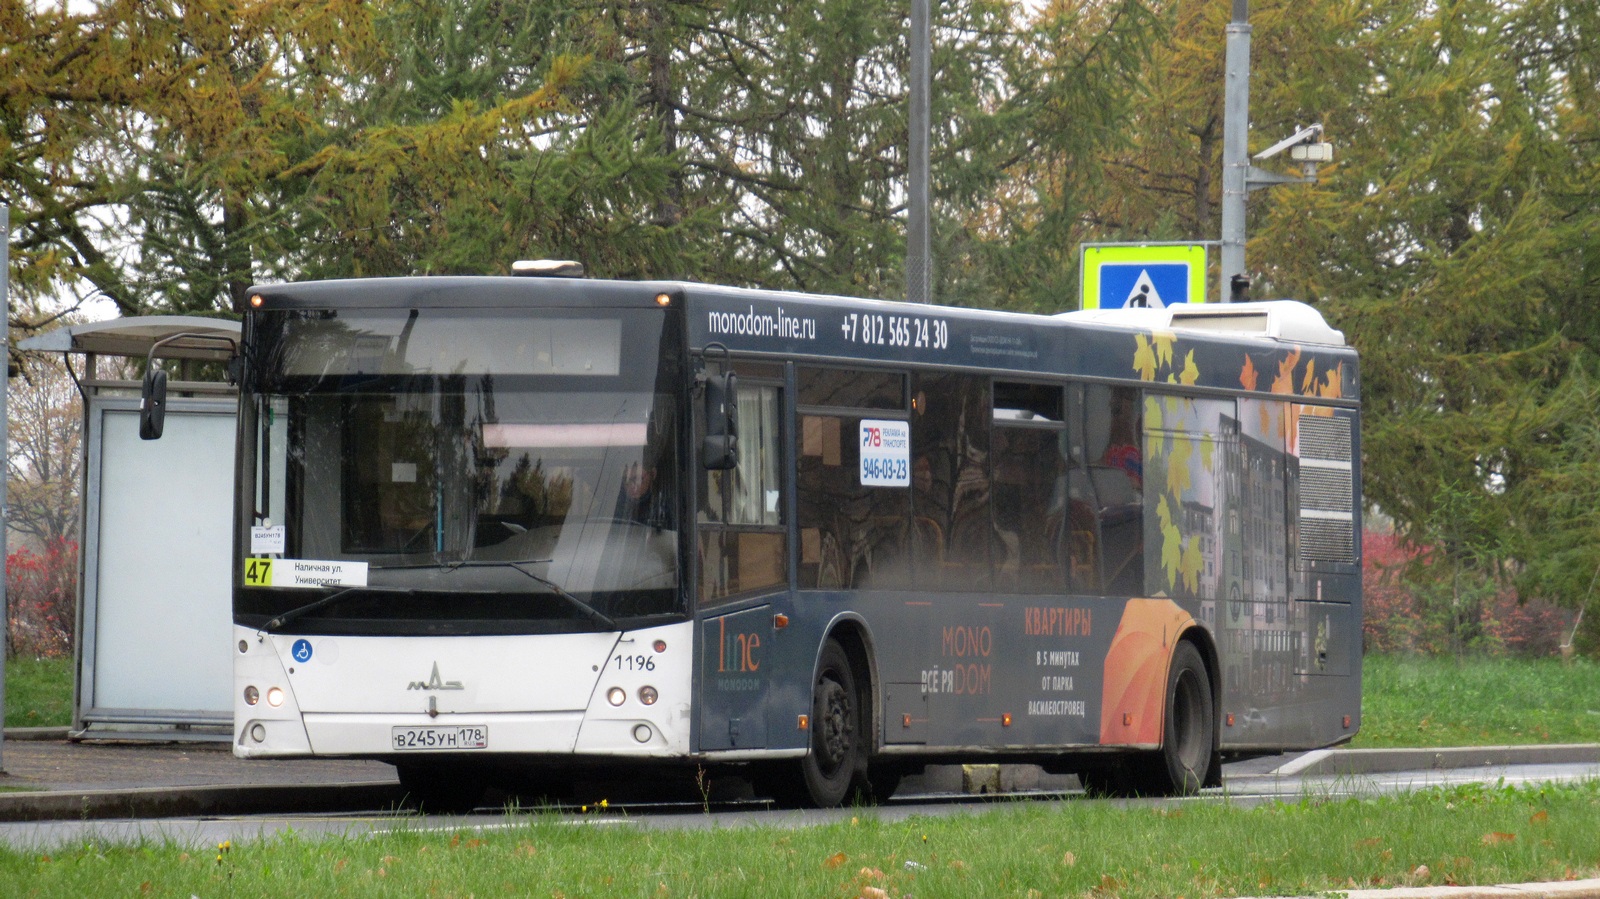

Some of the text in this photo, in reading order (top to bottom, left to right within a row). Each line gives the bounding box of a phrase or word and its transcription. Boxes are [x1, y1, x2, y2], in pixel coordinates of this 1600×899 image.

[709, 305, 815, 339] monodom-line.ru
[841, 313, 948, 349] +7 812 565 24 30
[883, 428, 900, 437] РЕКЛАМА
[883, 439, 906, 448] ТРАНСПОРТЕ
[863, 458, 907, 479] 946-03-23
[246, 561, 271, 583] 47
[294, 562, 342, 574] Наличная ул.
[295, 576, 341, 586] Университет
[1025, 607, 1091, 636] КВАРТИРЫ
[718, 617, 760, 672] line
[942, 626, 992, 657] MONO
[614, 655, 656, 671] 1196
[1036, 651, 1079, 668] В 5 МИНУТАХ
[718, 679, 760, 691] MONODOM
[921, 665, 938, 693] ВСЁ
[1042, 676, 1073, 691] ОТ ПАРКА
[1028, 700, 1085, 717] ВАСИЛЕОСТРОВЕЦ
[459, 729, 481, 741] 178
